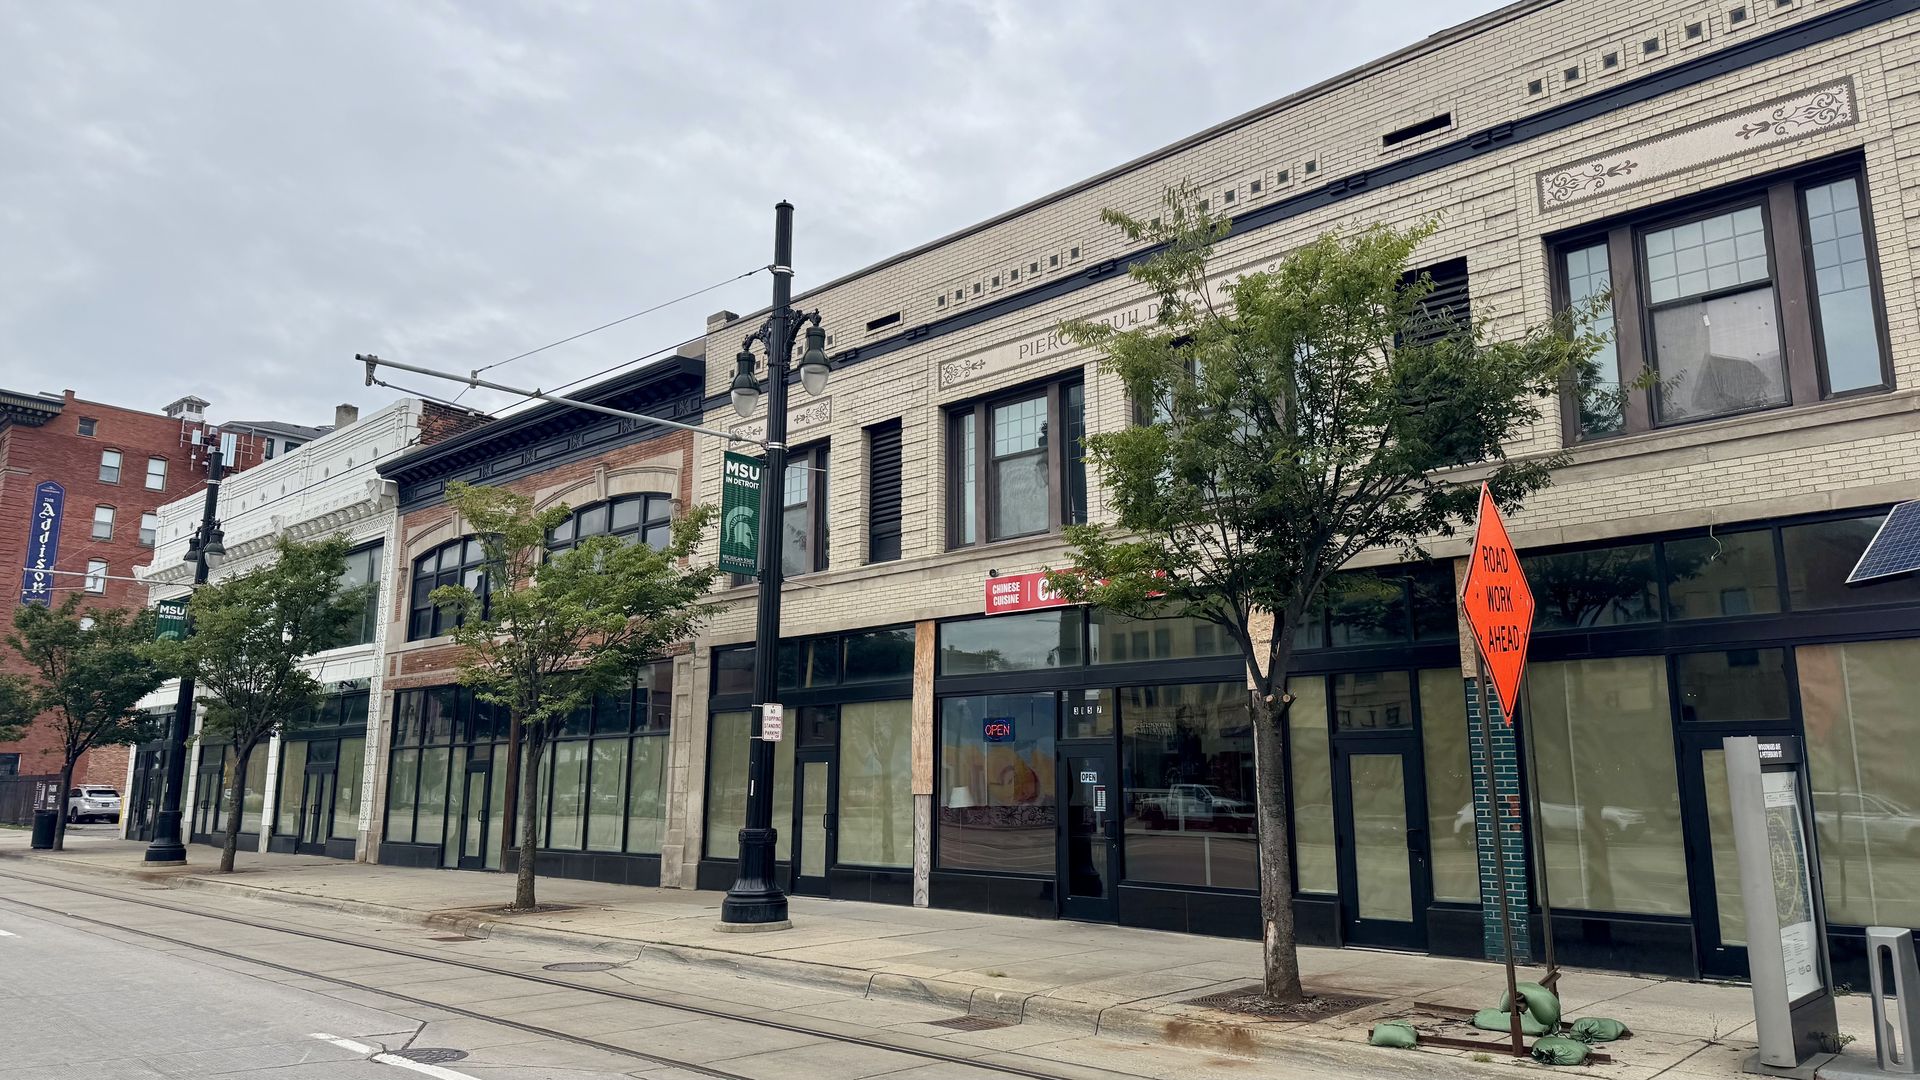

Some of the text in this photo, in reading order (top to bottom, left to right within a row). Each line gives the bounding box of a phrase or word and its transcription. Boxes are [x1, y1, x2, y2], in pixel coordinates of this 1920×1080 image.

[726, 460, 760, 481] MSU
[733, 478, 760, 489] DETROIT
[31, 502, 56, 594] Addison
[1482, 545, 1509, 573] ROAD
[992, 582, 1020, 595] CHINESE
[993, 594, 1020, 606] CUISINE
[1486, 585, 1514, 612] WORK
[160, 604, 185, 615] MSU
[1488, 625, 1520, 653] AHEAD
[985, 724, 1010, 736] OPEN
[1082, 773, 1096, 781] OPEN
